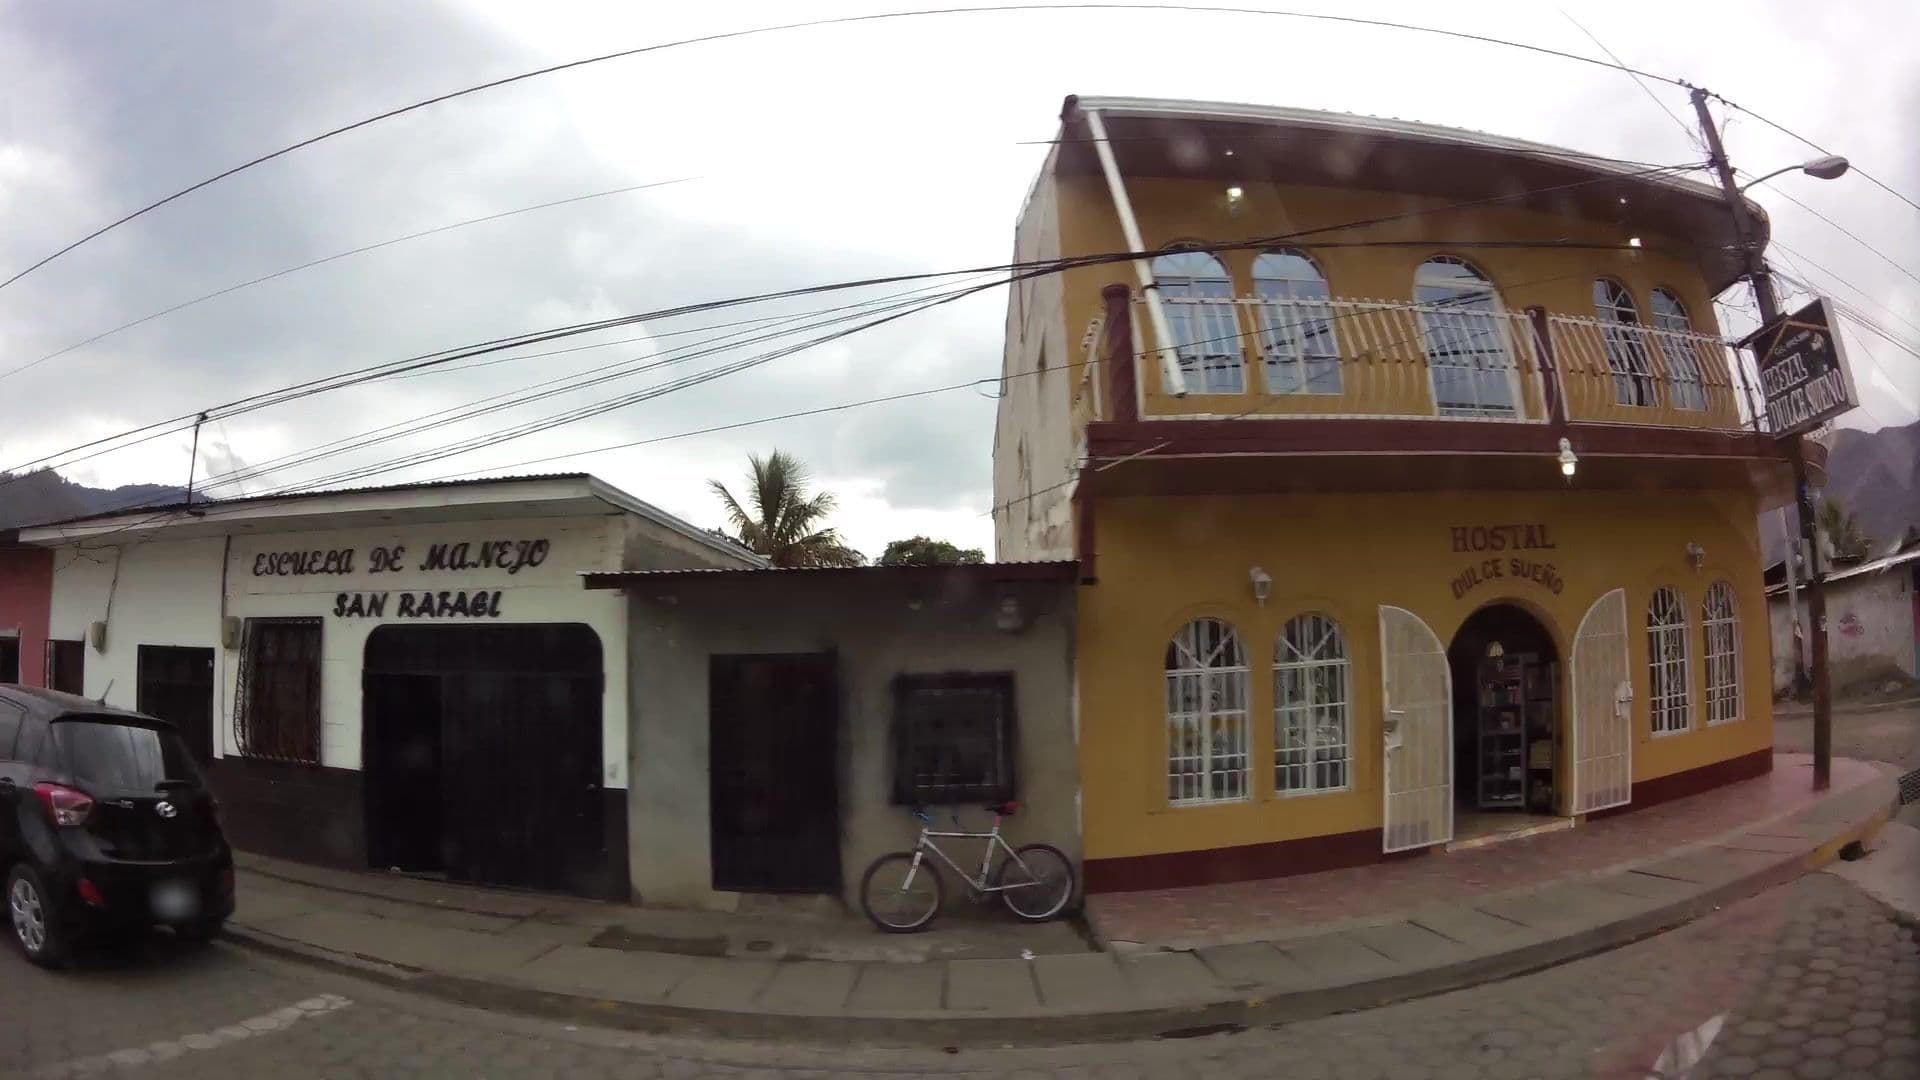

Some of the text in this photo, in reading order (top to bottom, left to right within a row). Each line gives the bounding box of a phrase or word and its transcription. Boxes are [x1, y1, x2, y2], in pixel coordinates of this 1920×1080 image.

[1762, 352, 1808, 398] HOSTAL
[253, 538, 550, 576] ESCUELA DE MANEJO
[1450, 524, 1556, 552] HOSTAL
[1451, 557, 1564, 600] DULCE SUEÑO
[333, 590, 502, 618] SAN RAFAEL
